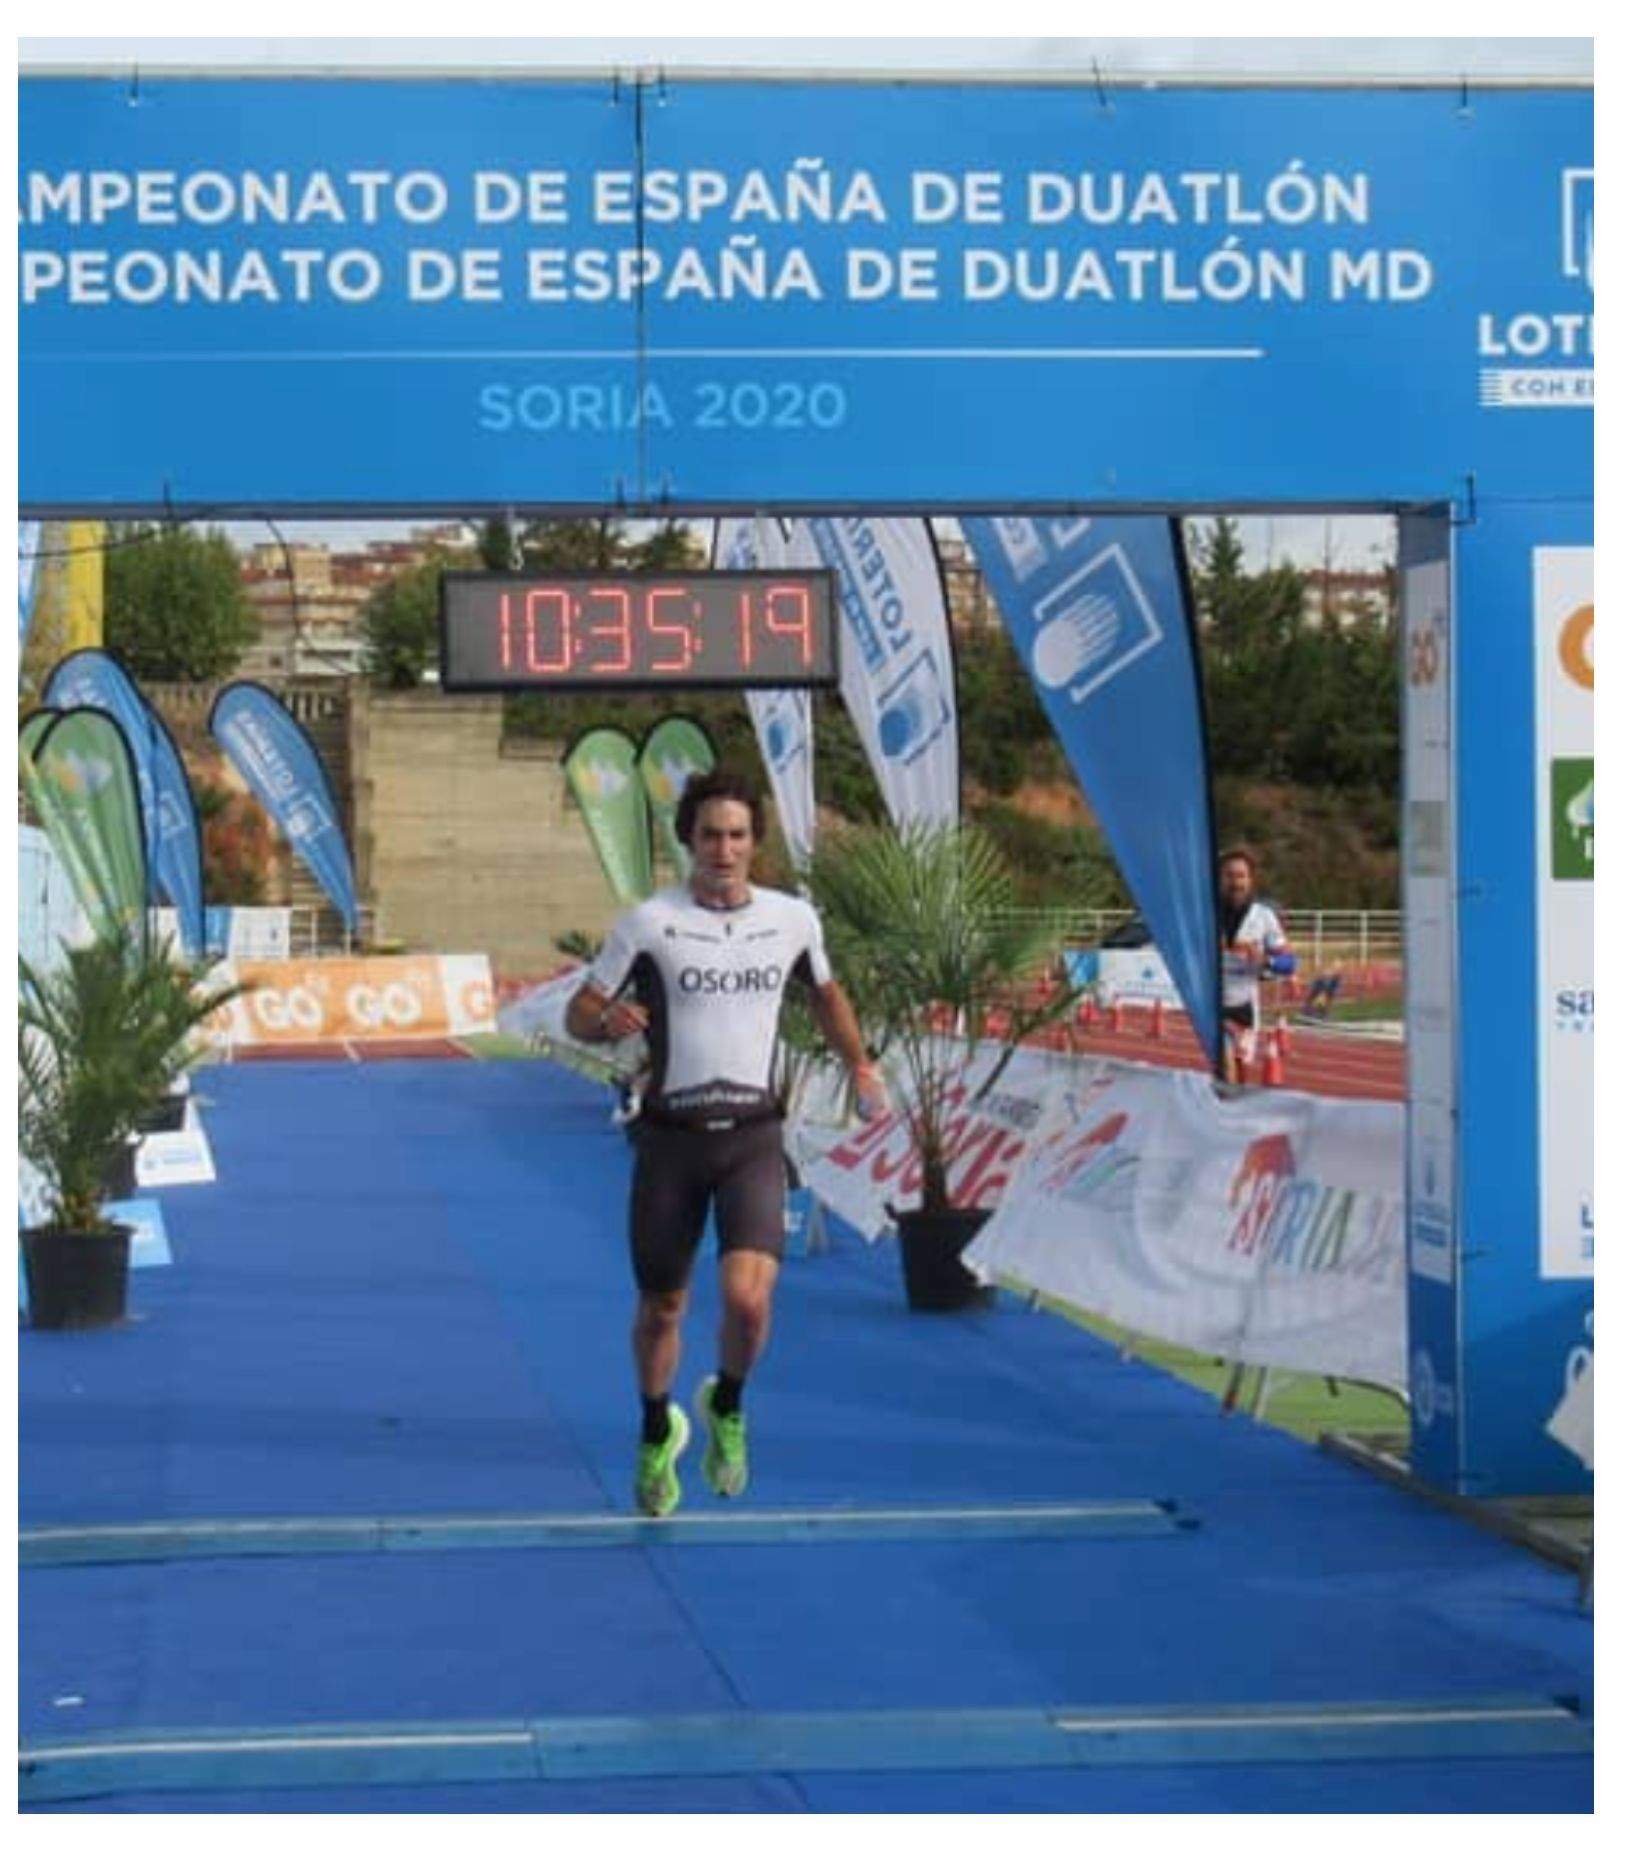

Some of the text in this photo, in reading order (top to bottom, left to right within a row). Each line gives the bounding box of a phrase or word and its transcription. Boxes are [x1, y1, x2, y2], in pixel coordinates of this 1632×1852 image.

[19, 156, 1368, 224] MPEONATO DE ESPAÑA DE DUATLÓN
[22, 234, 1433, 303] PEONATO DE ESPAÑA DE DUATLÓN MD
[1478, 313, 1593, 356] LOT
[478, 383, 846, 430] SORIA 2020
[499, 588, 812, 673] 10:35:19
[678, 965, 782, 994] OSORO
